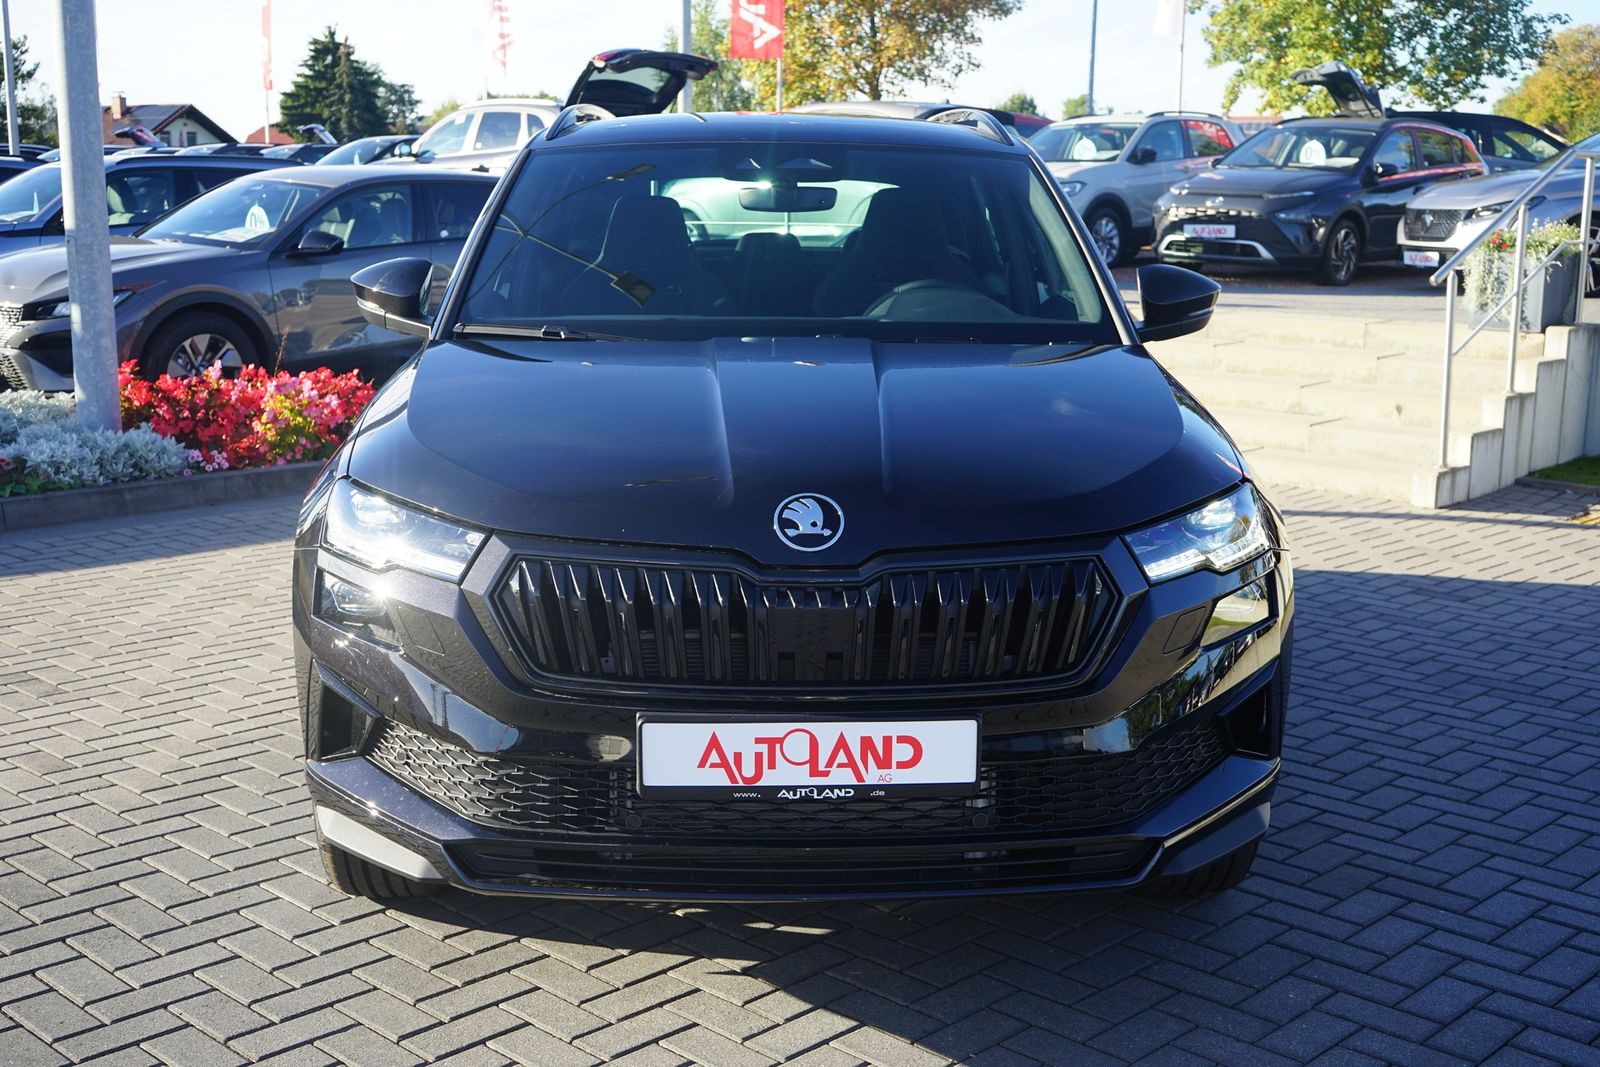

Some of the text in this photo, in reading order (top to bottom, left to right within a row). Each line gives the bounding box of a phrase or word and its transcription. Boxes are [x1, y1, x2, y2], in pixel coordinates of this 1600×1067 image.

[697, 728, 922, 785] AUTOLAND
[877, 774, 893, 783] AG
[777, 787, 854, 799] AUTOLAND
